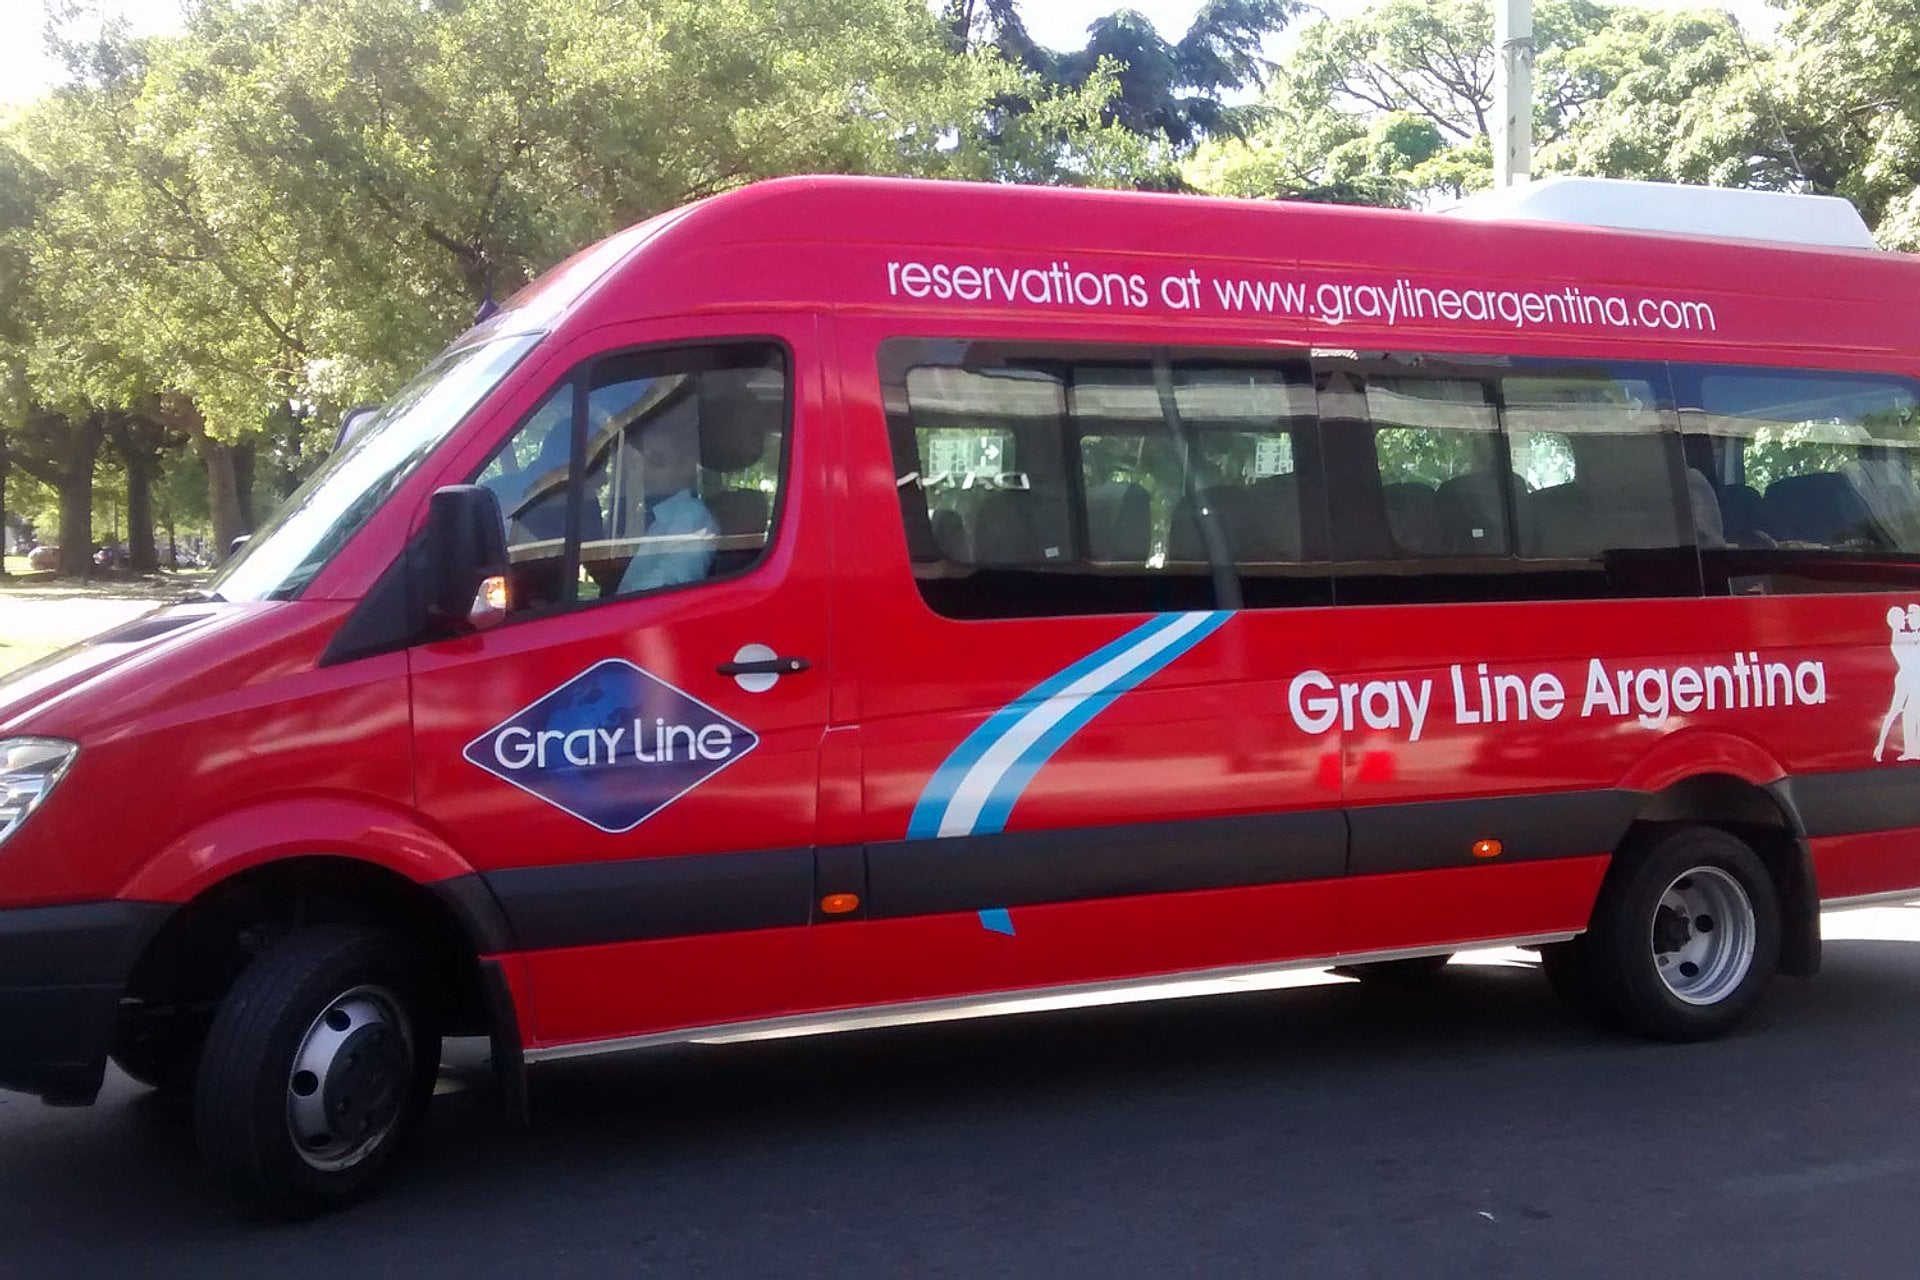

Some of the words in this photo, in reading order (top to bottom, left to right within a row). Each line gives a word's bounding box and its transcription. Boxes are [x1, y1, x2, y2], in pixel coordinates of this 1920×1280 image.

[887, 261, 1149, 308] reservations
[1160, 269, 1201, 309] at
[1213, 278, 1717, 331] www.graylineargentina.com
[1288, 670, 1432, 741] Gray
[1451, 662, 1565, 725] Line
[1580, 651, 1827, 730] Argentina
[634, 718, 732, 763] Line
